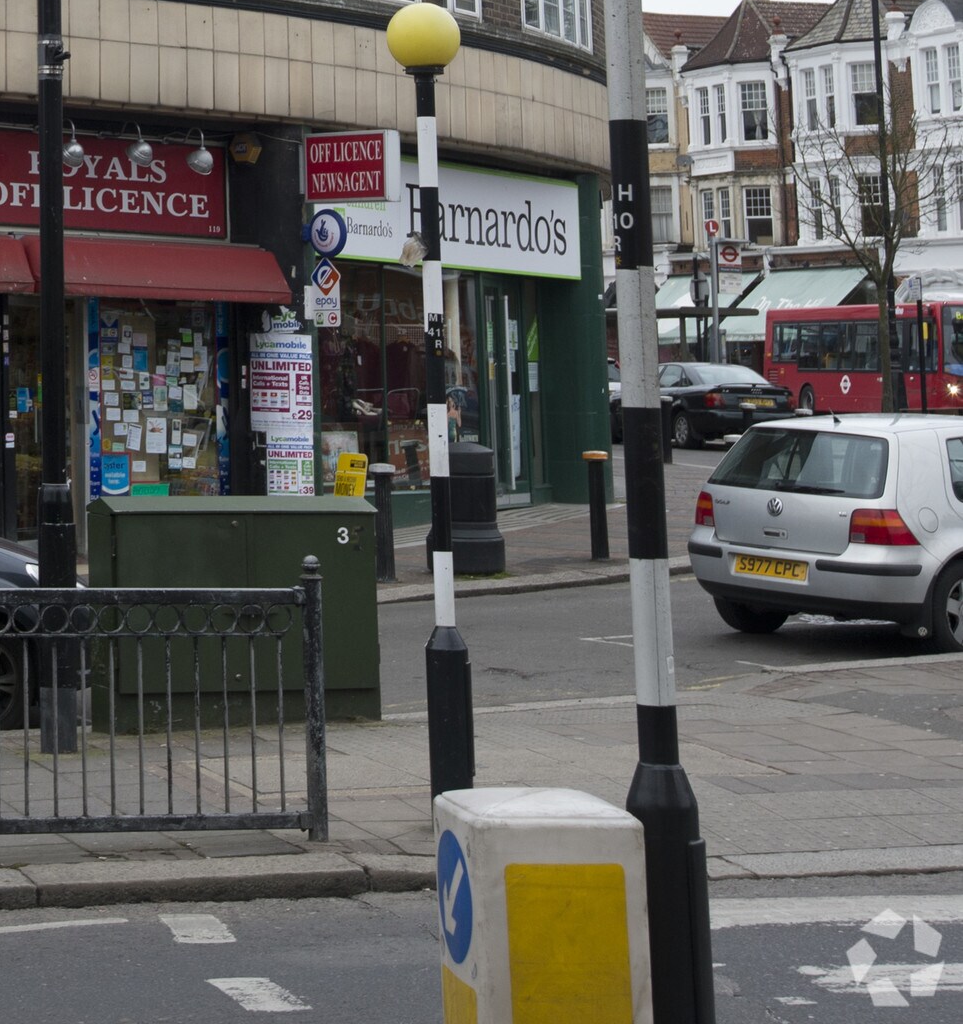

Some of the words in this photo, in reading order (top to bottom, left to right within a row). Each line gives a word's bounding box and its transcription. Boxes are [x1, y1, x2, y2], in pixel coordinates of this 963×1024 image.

[310, 143, 331, 164] OFF
[333, 140, 382, 162] LICENCE
[311, 170, 382, 193] NEWSAGENT
[63, 185, 209, 218] LICENCE
[346, 216, 393, 237] Barnardo's
[315, 297, 338, 308] epay
[255, 340, 307, 349] Lycamobile
[251, 360, 312, 372] UNLIMITED
[292, 409, 313, 420] £29
[268, 450, 313, 459] UNLIMITED
[337, 527, 350, 545] 3
[740, 557, 772, 574] S977
[774, 560, 801, 578] CPC
